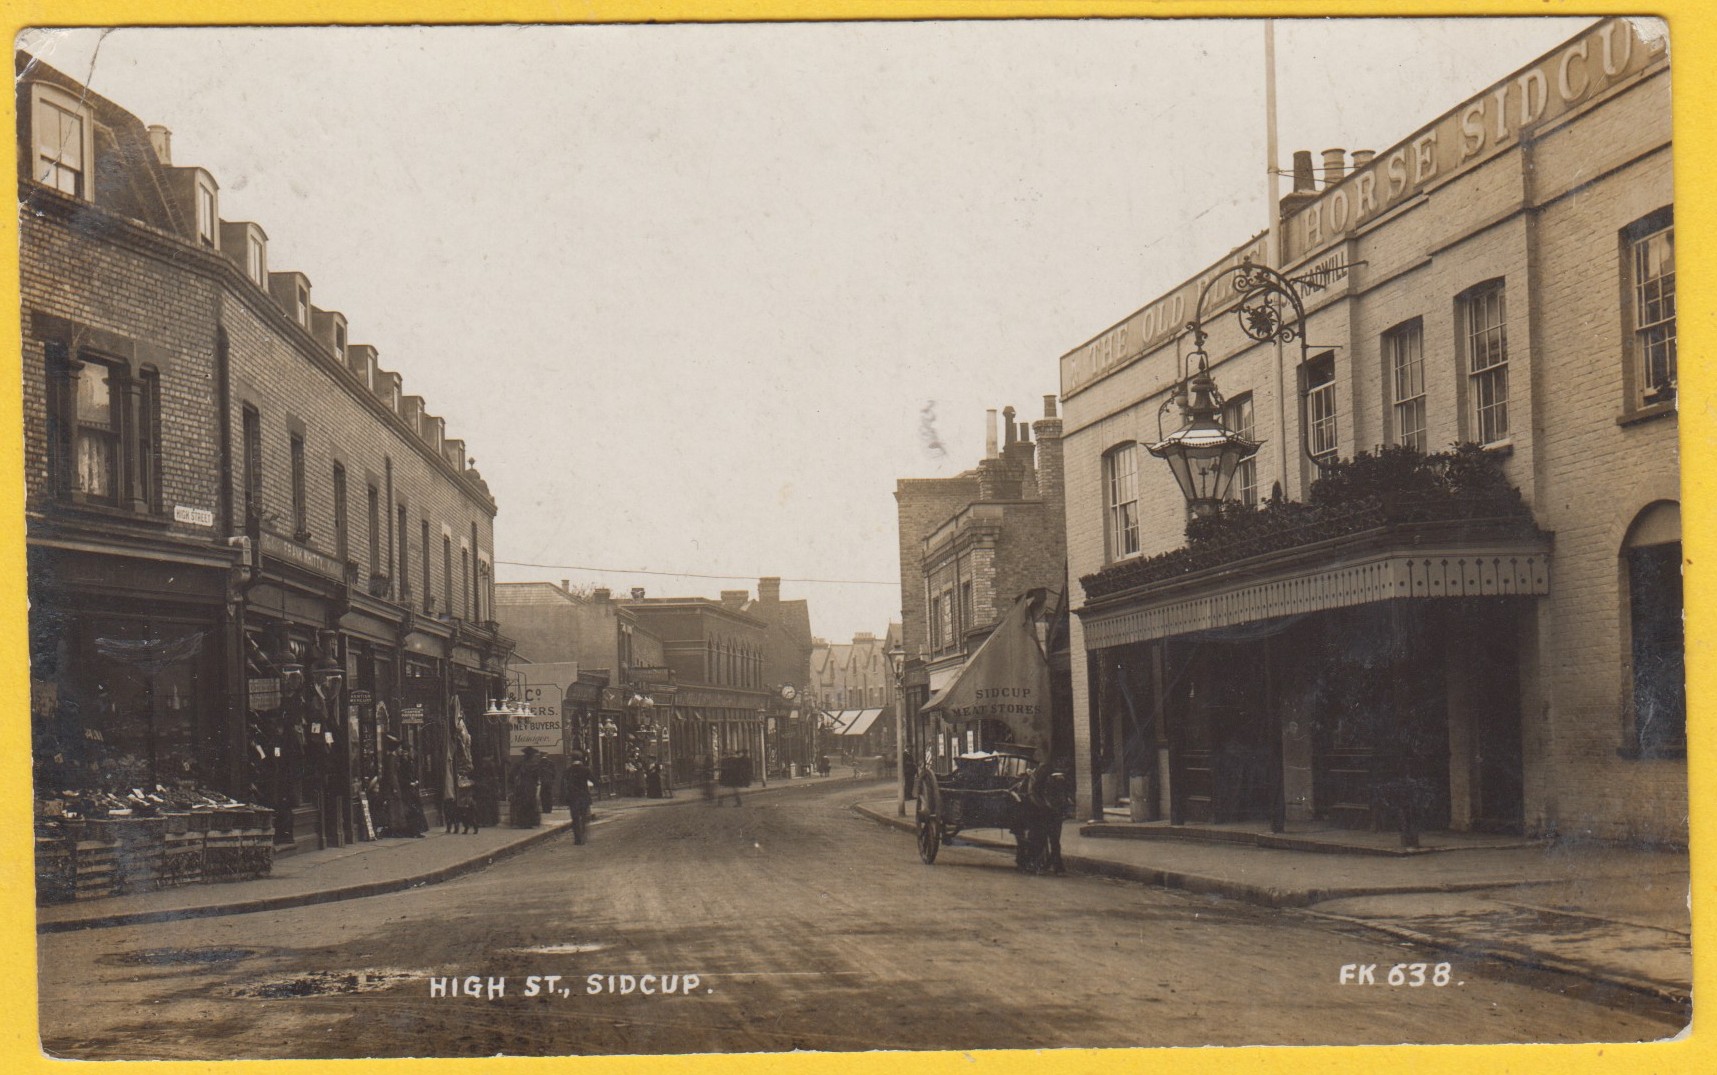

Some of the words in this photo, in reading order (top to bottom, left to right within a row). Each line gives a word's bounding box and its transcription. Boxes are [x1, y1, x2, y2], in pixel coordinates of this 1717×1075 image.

[1088, 327, 1128, 374] THE
[1142, 294, 1185, 343] OLD
[1303, 129, 1438, 248] HORSE
[1460, 19, 1667, 158] SIDCU
[176, 509, 190, 520] HIGH
[190, 511, 212, 524] STREET
[976, 687, 1031, 699] SIDCUP
[952, 705, 987, 717] MEAT
[991, 703, 1042, 715] STORES
